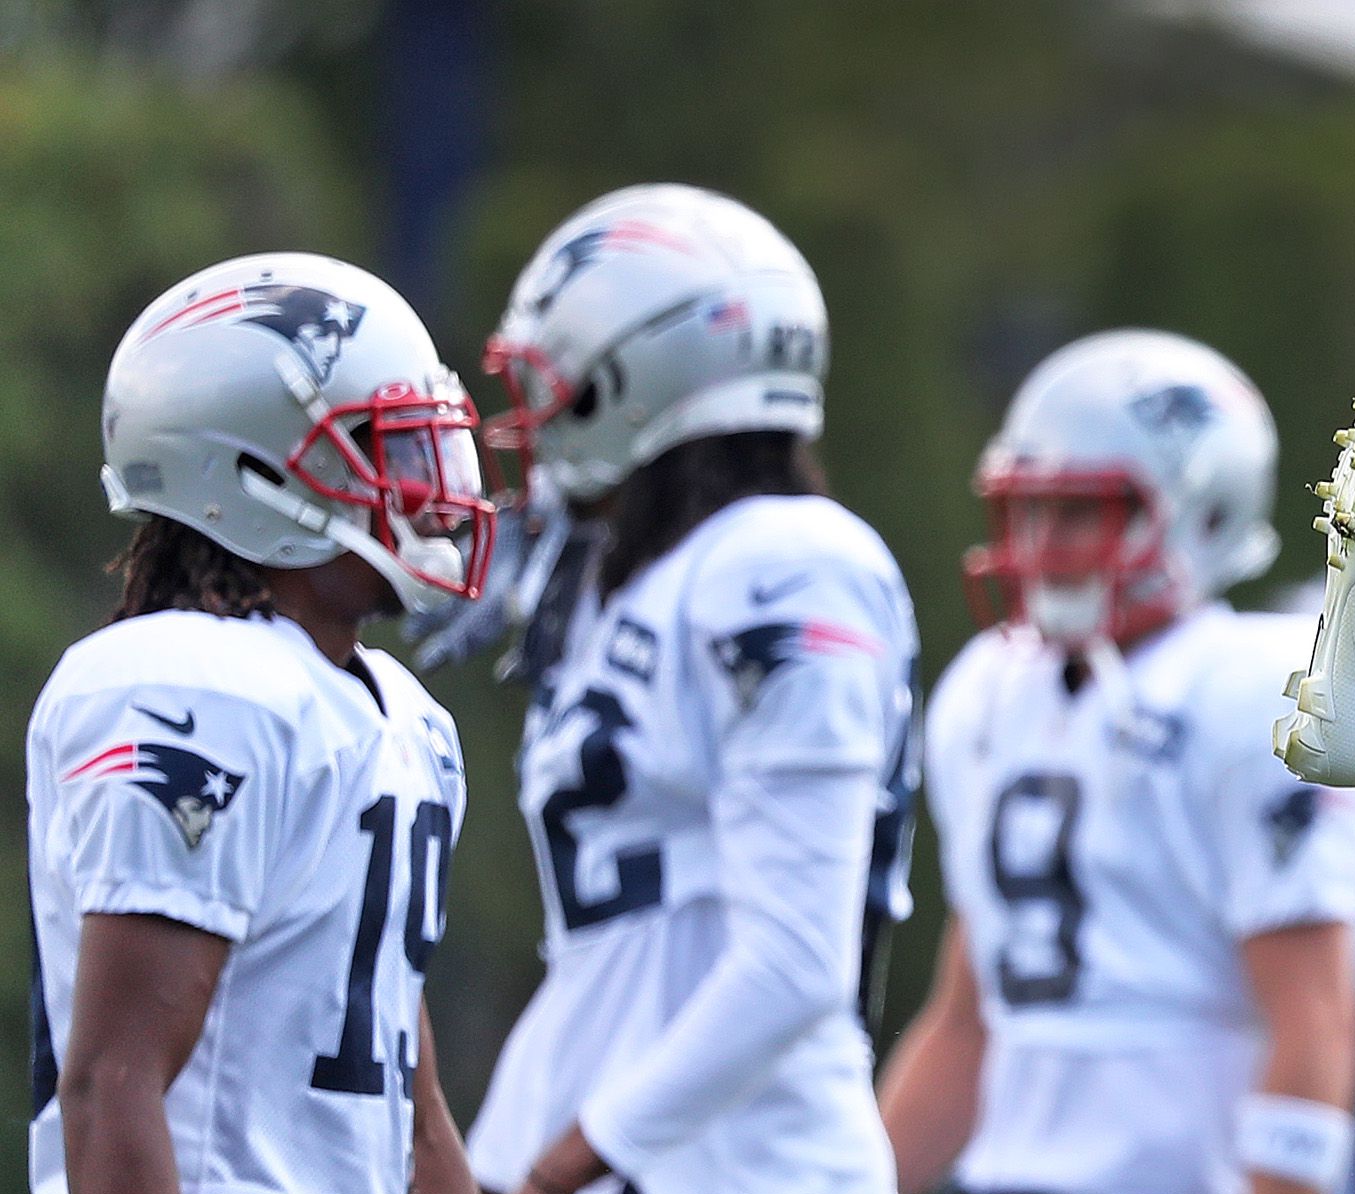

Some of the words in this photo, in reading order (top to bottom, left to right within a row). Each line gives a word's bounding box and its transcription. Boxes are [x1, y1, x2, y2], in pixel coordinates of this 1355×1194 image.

[532, 687, 664, 930] 2
[988, 773, 1086, 1006] 9
[310, 795, 452, 1100] 19
